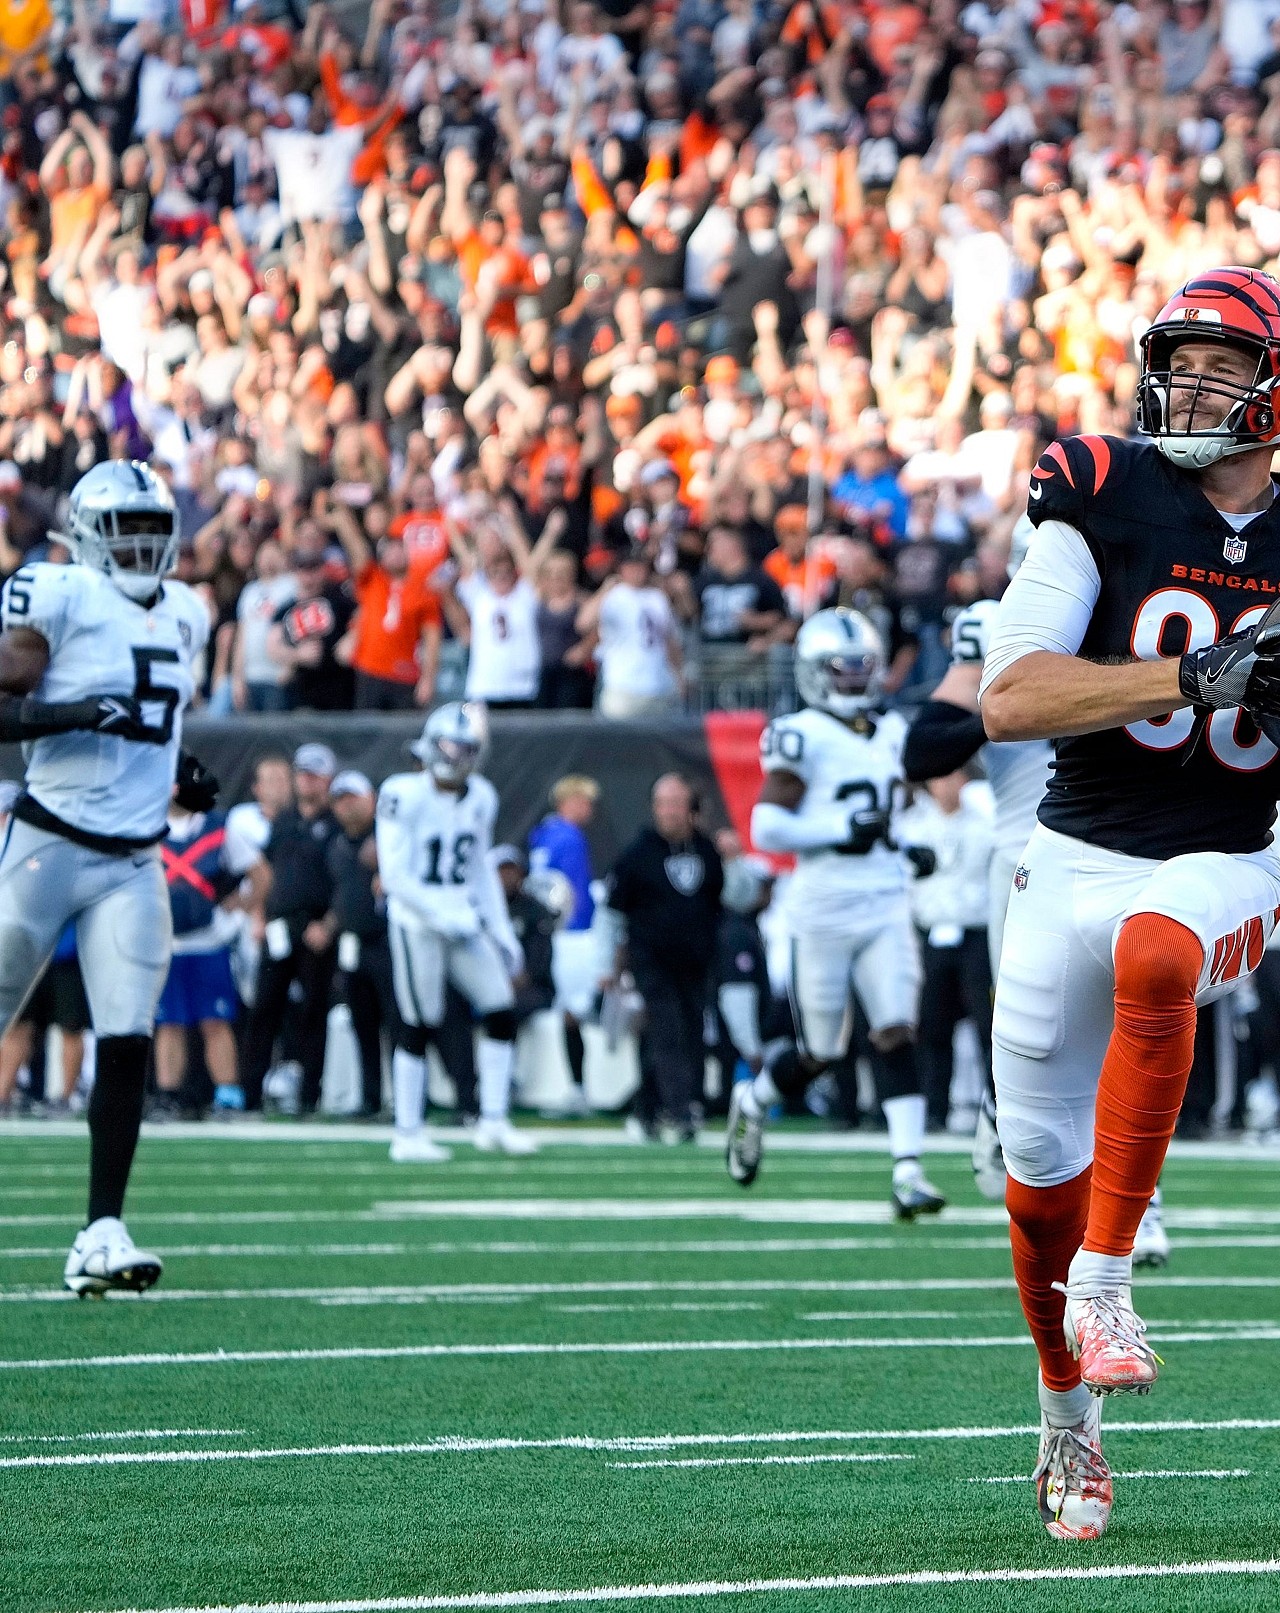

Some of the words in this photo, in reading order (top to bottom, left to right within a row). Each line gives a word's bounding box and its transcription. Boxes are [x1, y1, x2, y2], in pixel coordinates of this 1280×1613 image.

[1226, 546, 1243, 560] NFL
[8, 574, 35, 616] 5
[122, 646, 180, 746] 5
